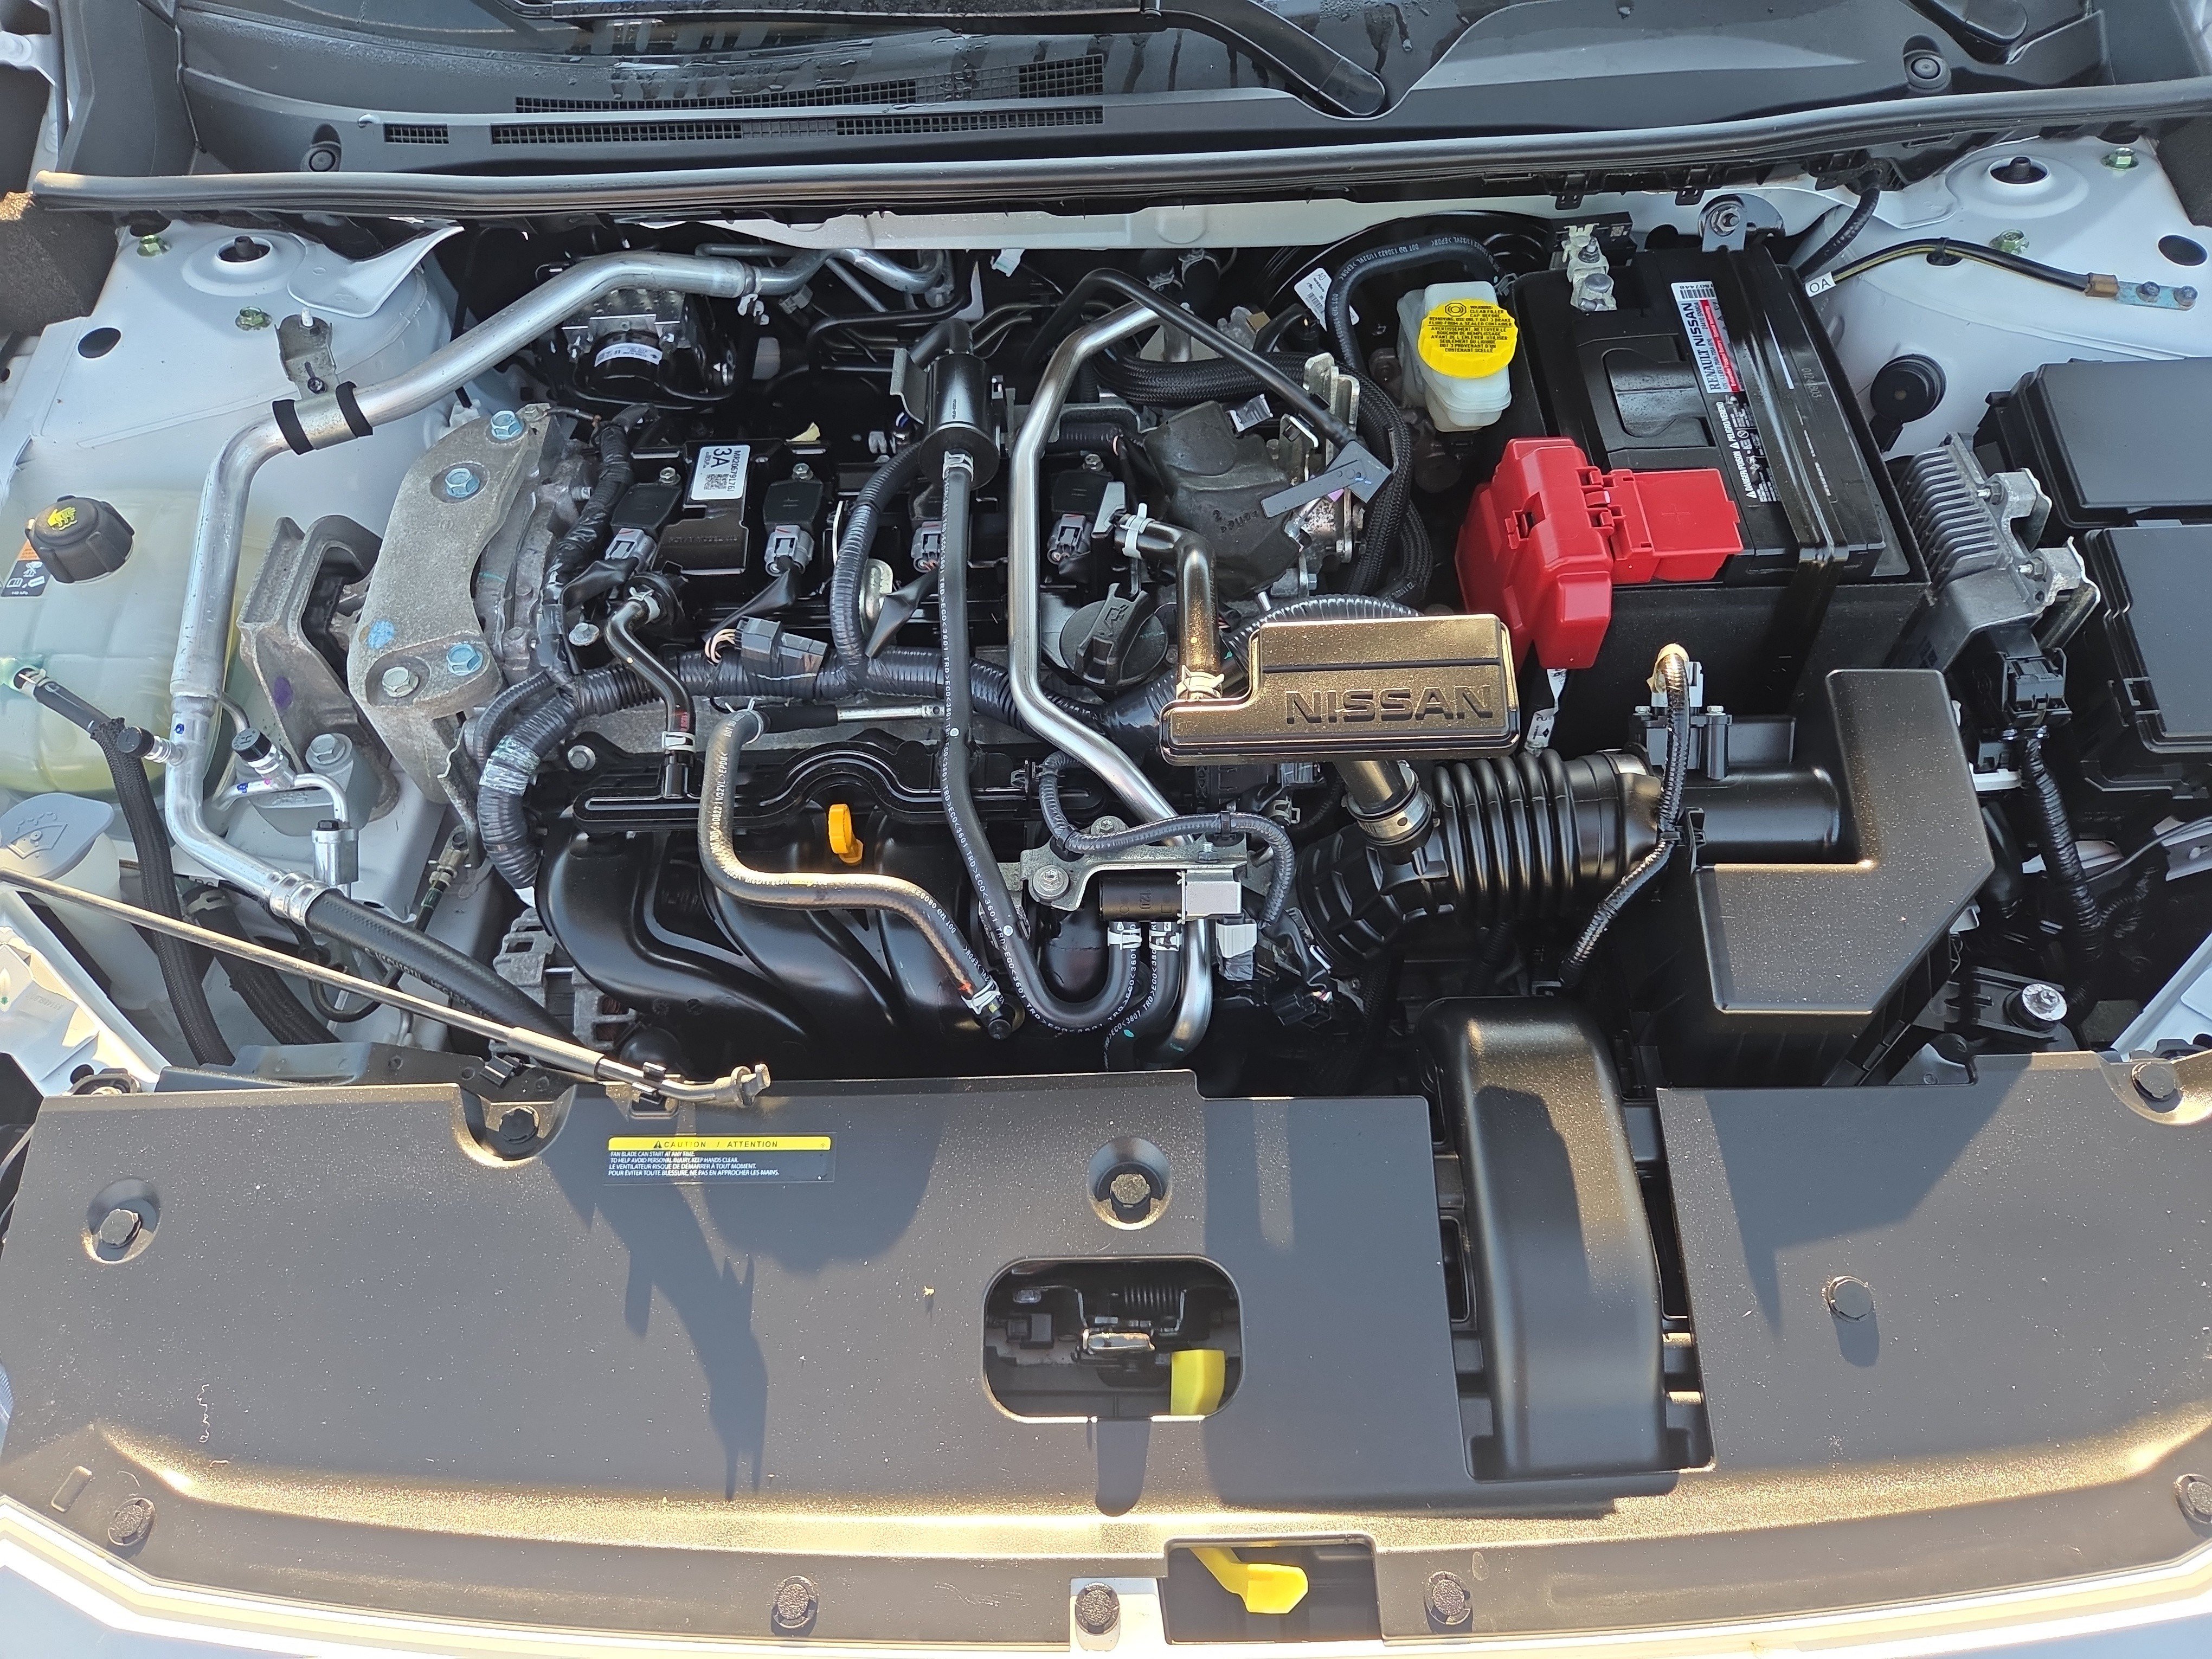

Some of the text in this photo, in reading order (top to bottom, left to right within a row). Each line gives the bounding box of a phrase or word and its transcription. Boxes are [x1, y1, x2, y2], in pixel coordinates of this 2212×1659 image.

[1681, 303, 1706, 346] NISSAN
[1698, 349, 1721, 390] RENAULT
[711, 448, 732, 468] 3A
[1285, 685, 1493, 724] NISSAN
[942, 785, 969, 849] TRD>ECO<3601
[966, 850, 999, 922] TRD>ECO<3601
[1143, 949, 1158, 1011] TRD>ECO<380
